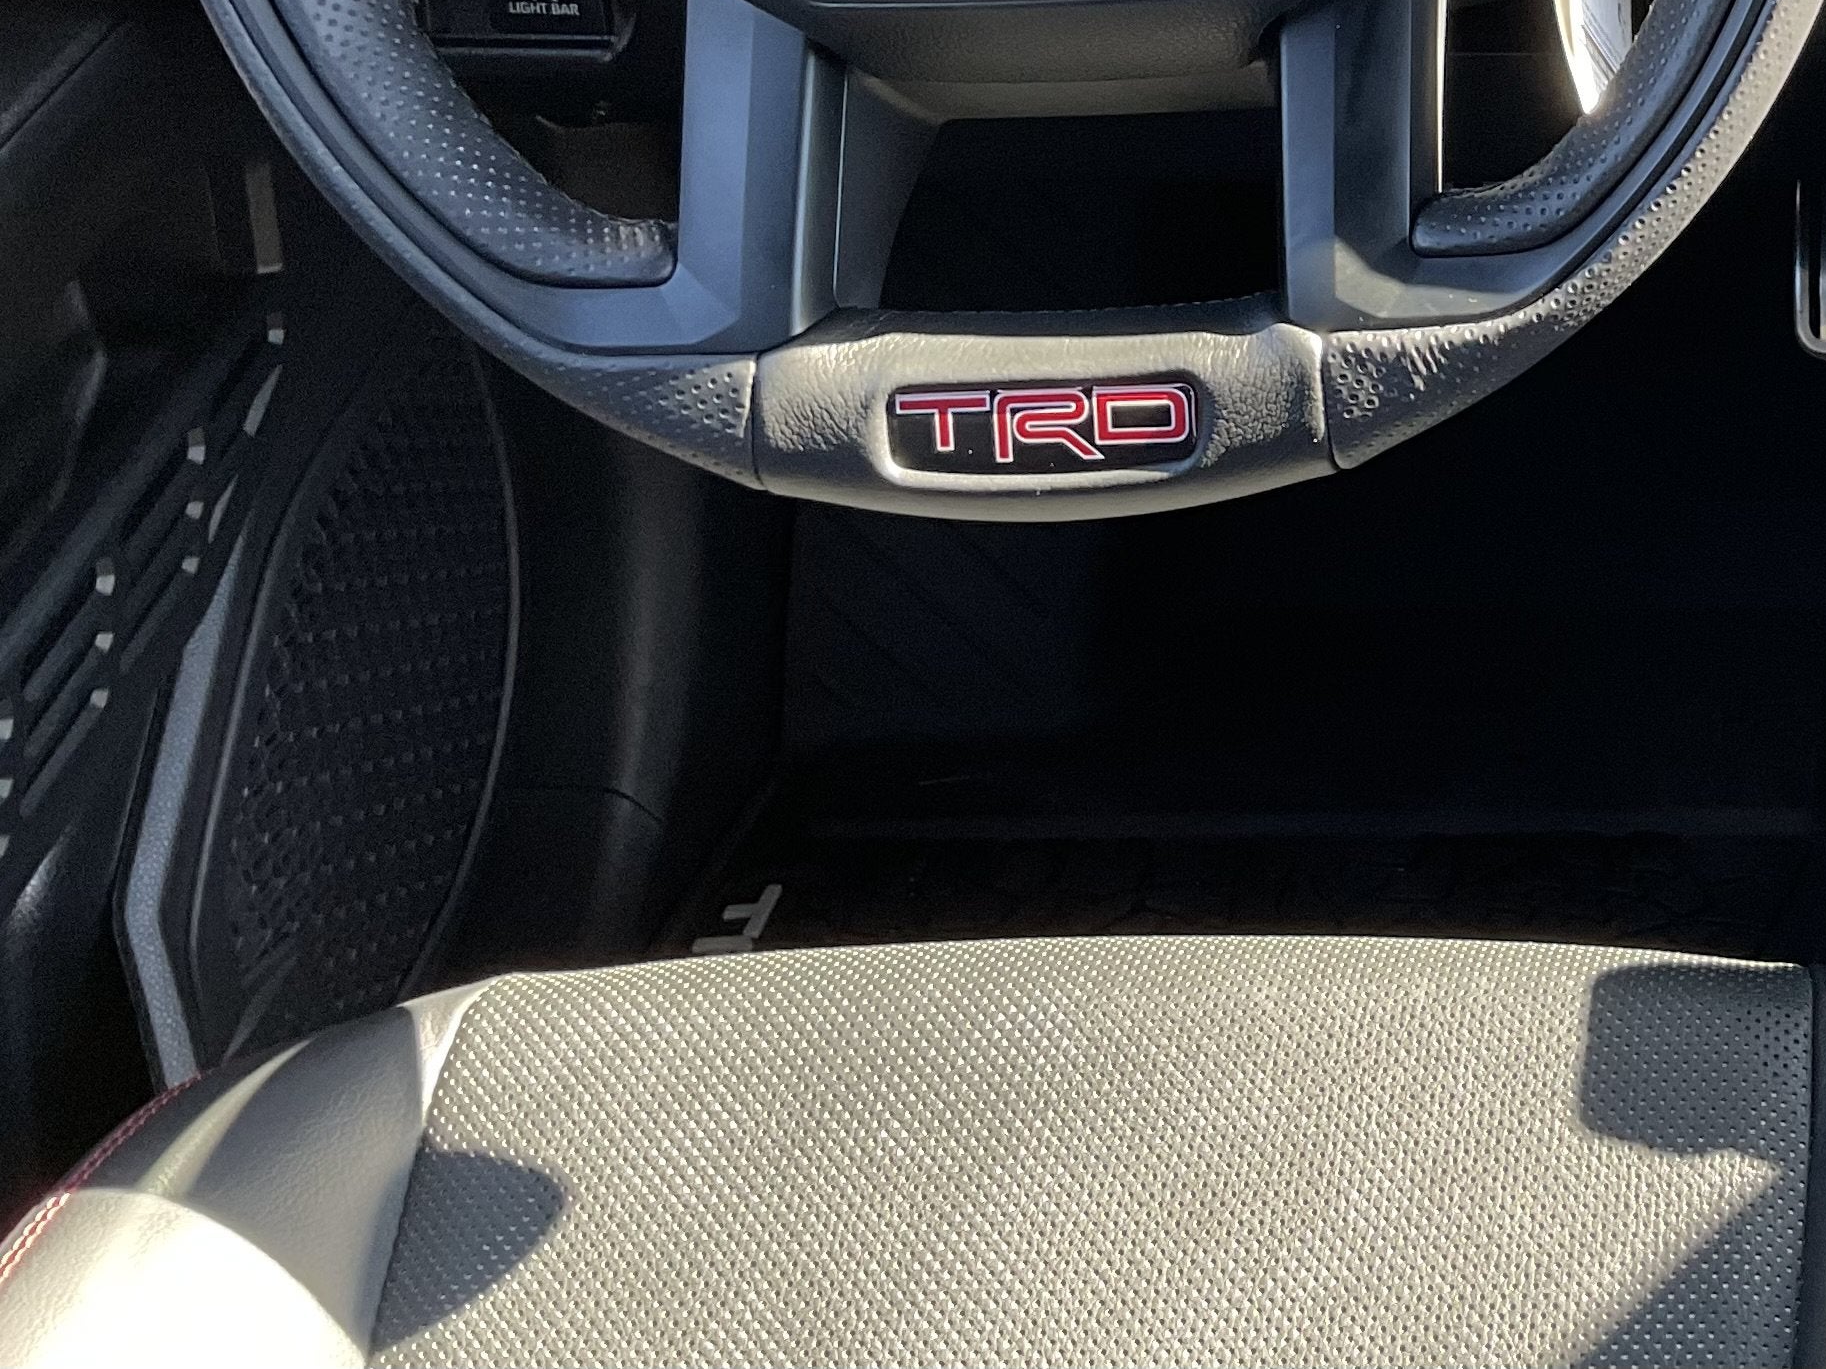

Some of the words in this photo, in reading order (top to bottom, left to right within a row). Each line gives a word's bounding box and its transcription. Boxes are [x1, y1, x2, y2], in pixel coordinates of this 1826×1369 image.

[509, 2, 549, 15] LIGHT
[551, 3, 580, 16] BAR
[895, 382, 1197, 463] TRD
